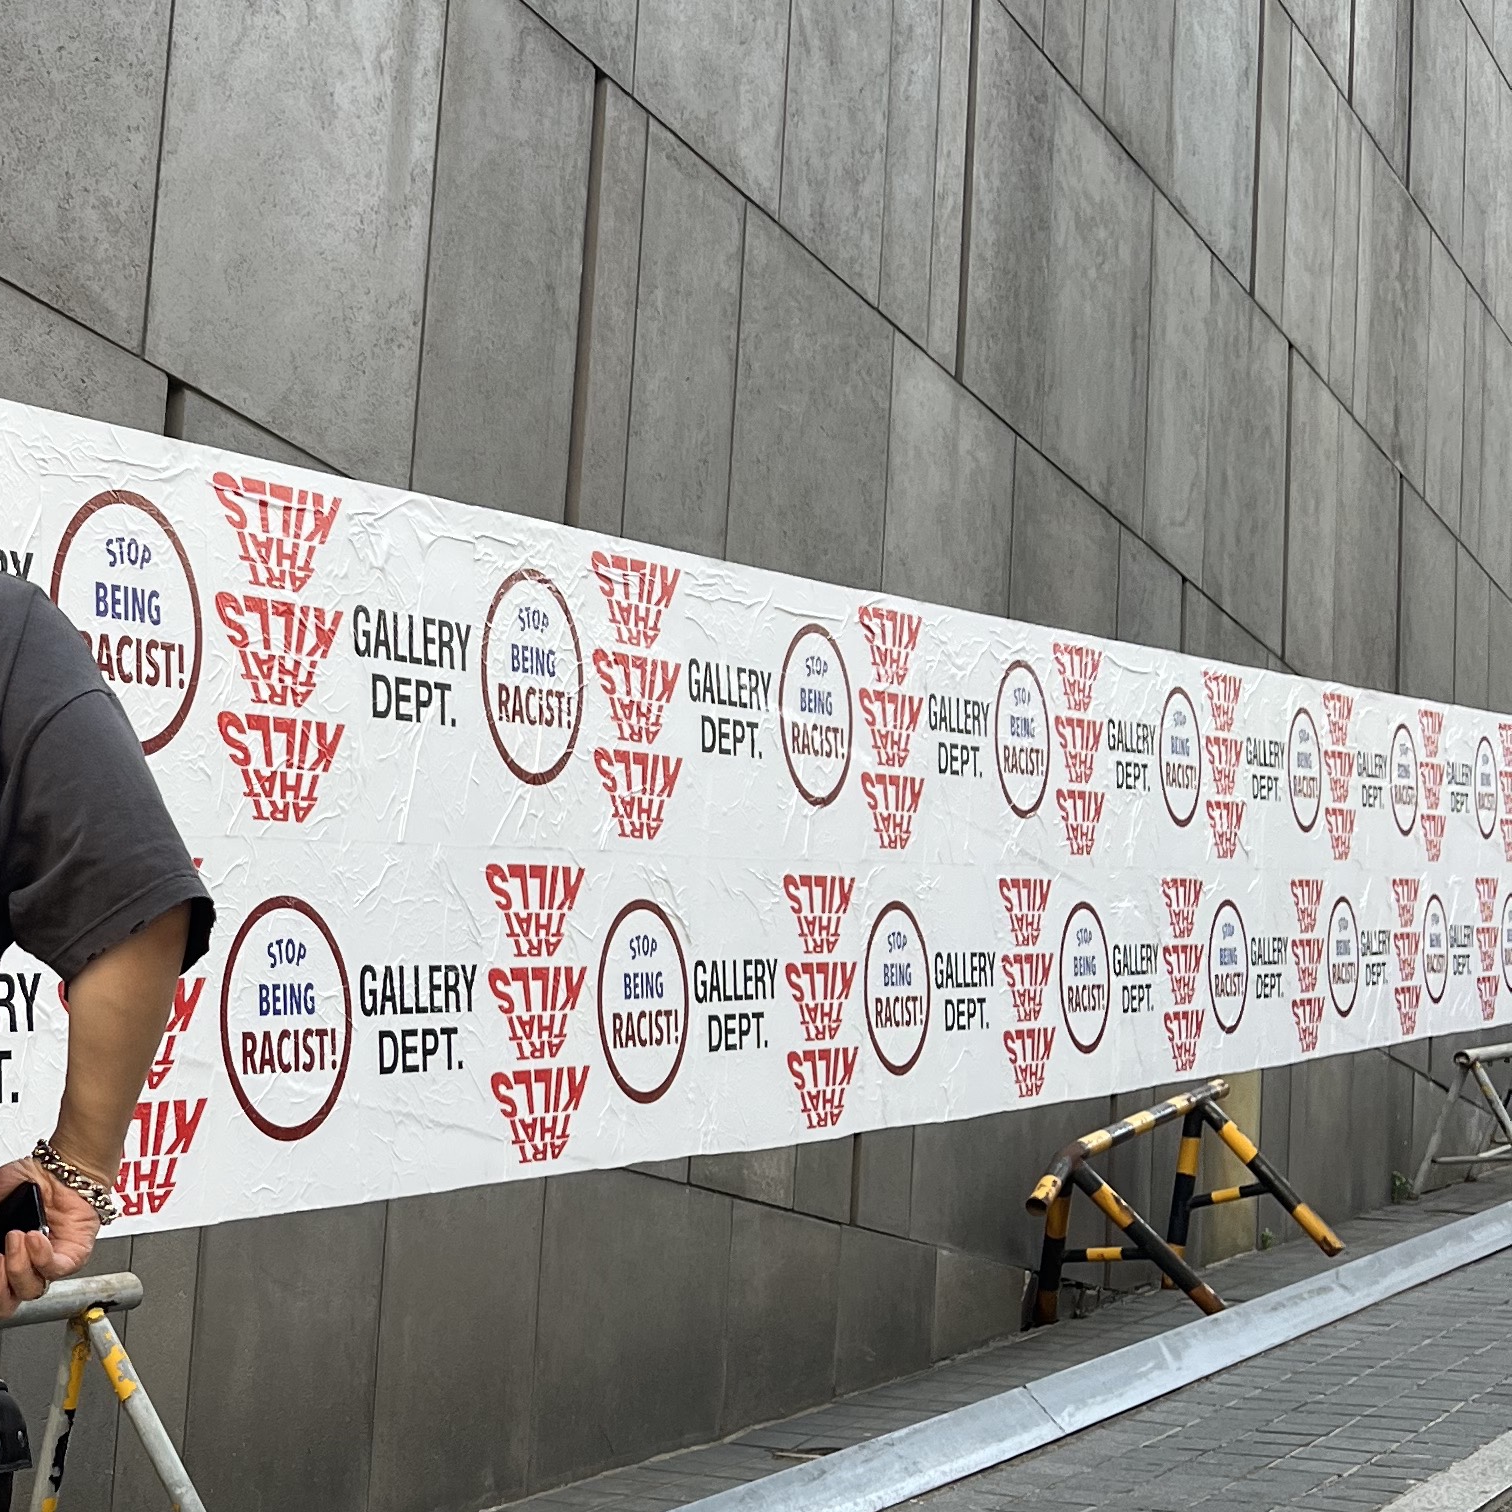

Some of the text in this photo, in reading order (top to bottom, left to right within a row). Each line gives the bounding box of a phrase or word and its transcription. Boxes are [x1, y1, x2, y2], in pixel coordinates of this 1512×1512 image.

[213, 472, 342, 544] KILLS
[106, 537, 151, 569] STOP
[237, 531, 316, 574] THAT
[248, 566, 315, 592] ART
[591, 551, 680, 608] KILLS
[96, 582, 160, 625] BEING
[607, 599, 662, 632] THAT
[215, 592, 343, 659] KILLS
[518, 607, 549, 633] STOP
[353, 605, 471, 671] GALLERY
[614, 625, 661, 649] ART
[240, 651, 318, 693] THAT
[512, 644, 555, 677] BEING
[592, 648, 681, 703] KILLS
[806, 656, 828, 677] STOP
[250, 681, 316, 708] ART
[372, 673, 456, 727] DEPT.
[689, 658, 771, 710] GALLERY
[498, 683, 572, 729] RACIST!
[609, 697, 663, 727] THAT
[800, 688, 832, 716] BEING
[859, 688, 923, 732] KILLS
[929, 694, 990, 737] GALLERY
[217, 711, 345, 772] KILLS
[616, 722, 662, 744] ART
[701, 715, 762, 759] DEPT.
[792, 722, 844, 759] RACIST!
[1108, 719, 1156, 755] GALLERY
[938, 742, 982, 778] DEPT.
[1004, 745, 1043, 776] RACIST!
[1246, 737, 1284, 769] GALLERY
[241, 769, 319, 802] THAT
[594, 747, 682, 798] KILLS
[1116, 761, 1150, 792] DEPT.
[1252, 774, 1281, 801] DEPT.
[610, 794, 664, 822] THAT
[861, 772, 924, 813] KILLS
[252, 796, 317, 823] ART
[873, 811, 911, 834] THAT
[618, 818, 664, 839] ART
[486, 864, 585, 911] KILLS
[783, 874, 855, 914] KILLS
[504, 912, 565, 937] THAT
[797, 915, 841, 938] THAT
[268, 939, 306, 968] STOP
[514, 938, 562, 957] ART
[630, 935, 657, 960] STOP
[803, 936, 840, 954] ART
[888, 931, 907, 953] STOP
[1251, 937, 1288, 966] GALLERY
[883, 963, 912, 987] BEING
[935, 952, 995, 989] GALLERY
[1113, 944, 1158, 977] GALLERY
[360, 964, 477, 1017] GALLERY
[488, 966, 587, 1014] KILLS
[624, 971, 663, 999] BEING
[694, 959, 777, 1003] GALLERY
[785, 962, 857, 1002] KILLS
[1256, 973, 1283, 999] DEPT.
[259, 983, 315, 1016] BEING
[799, 1002, 842, 1025] THAT
[875, 996, 923, 1028] RACIST!
[1068, 984, 1104, 1012] RACIST!
[1122, 984, 1153, 1013] DEPT.
[507, 1014, 567, 1041] THAT
[613, 1009, 678, 1048] RACIST!
[945, 998, 989, 1031] DEPT.
[708, 1012, 768, 1052] DEPT.
[805, 1022, 842, 1041] ART
[242, 1028, 336, 1075] RACIST!
[379, 1027, 463, 1075] DEPT.
[517, 1039, 564, 1060] ART
[787, 1047, 858, 1090] KILLS
[491, 1066, 590, 1118] KILLS
[801, 1088, 845, 1113] THAT
[510, 1114, 570, 1145] THAT
[807, 1109, 844, 1129] ART
[519, 1140, 567, 1163] ART
